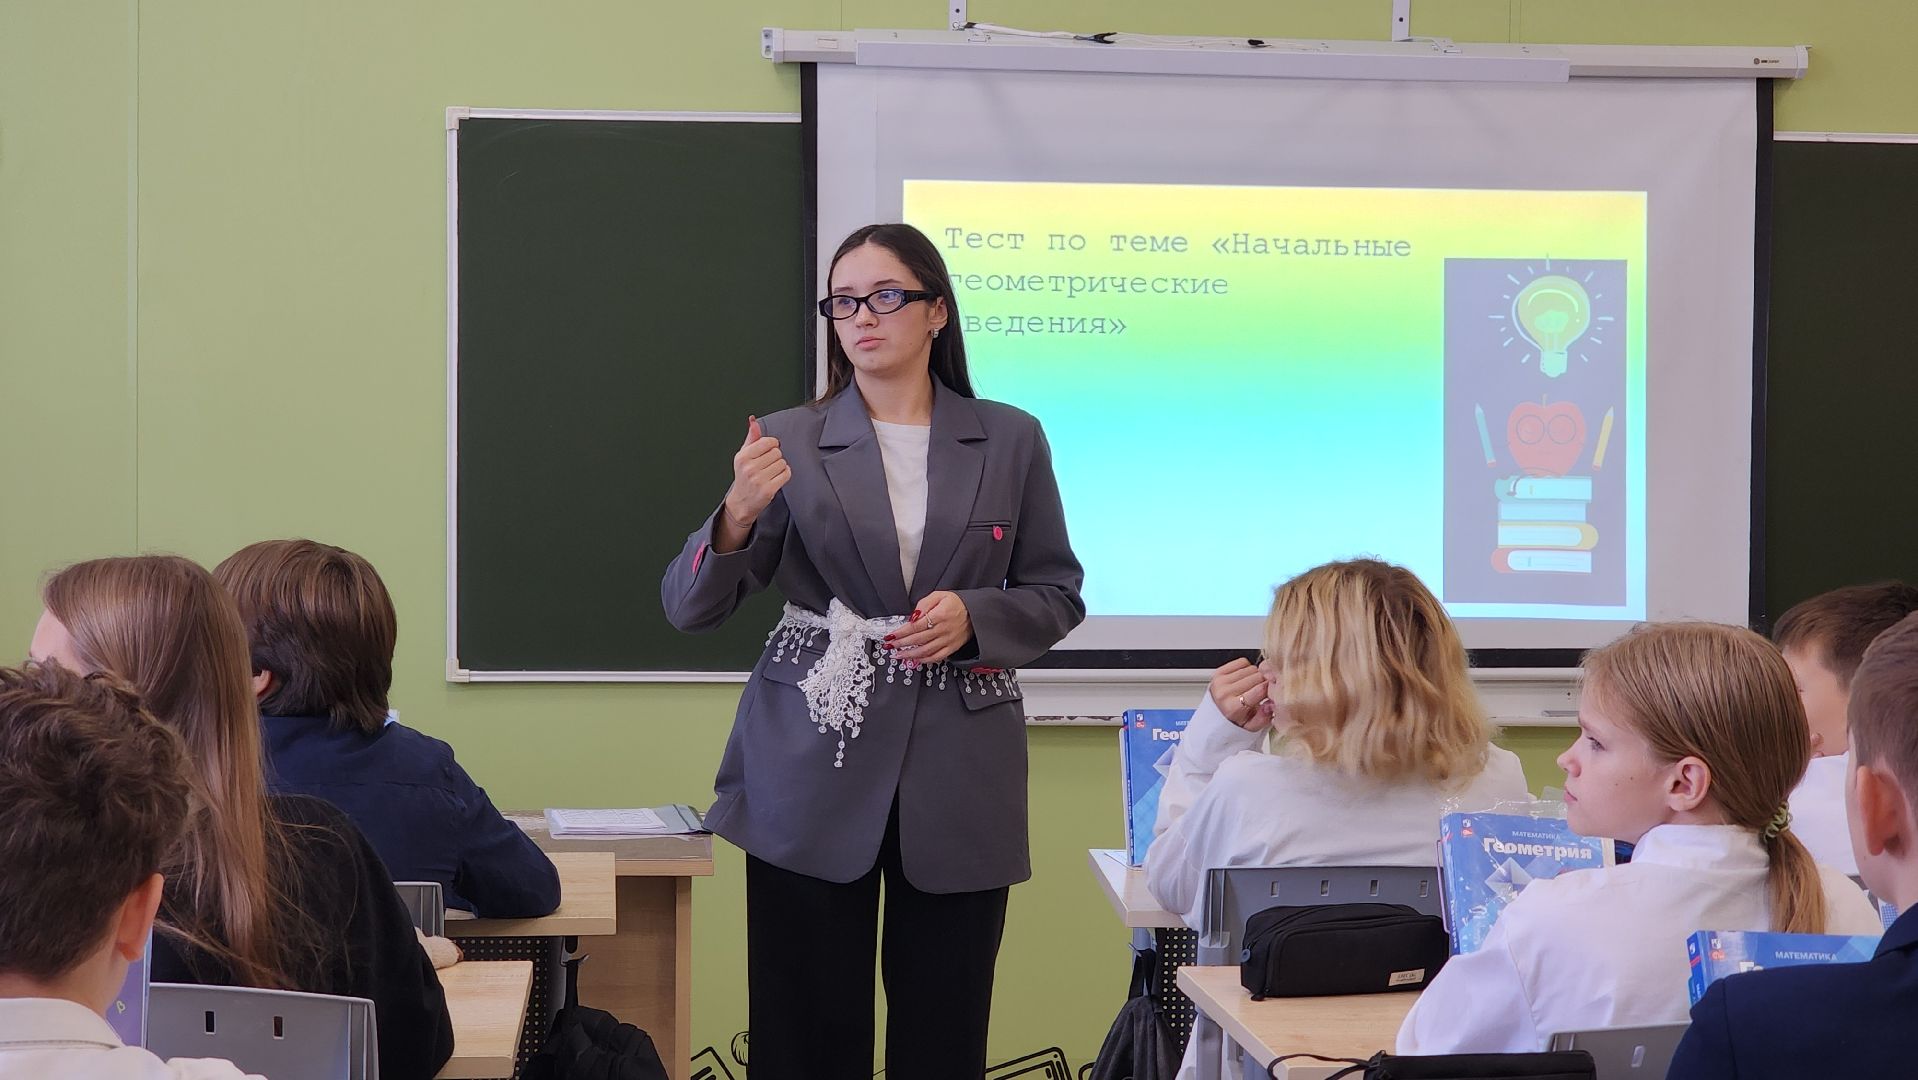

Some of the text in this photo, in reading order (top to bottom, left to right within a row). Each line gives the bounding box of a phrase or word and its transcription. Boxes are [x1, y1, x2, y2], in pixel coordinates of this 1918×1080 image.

[945, 227, 1412, 257] Тест по теме «Начальные
[964, 314, 1127, 336] ведения»
[1512, 830, 1561, 841] МАТЕМАТИКА
[1483, 837, 1592, 861] Геометрия
[1775, 951, 1838, 961] МАТЕМАТИКА
